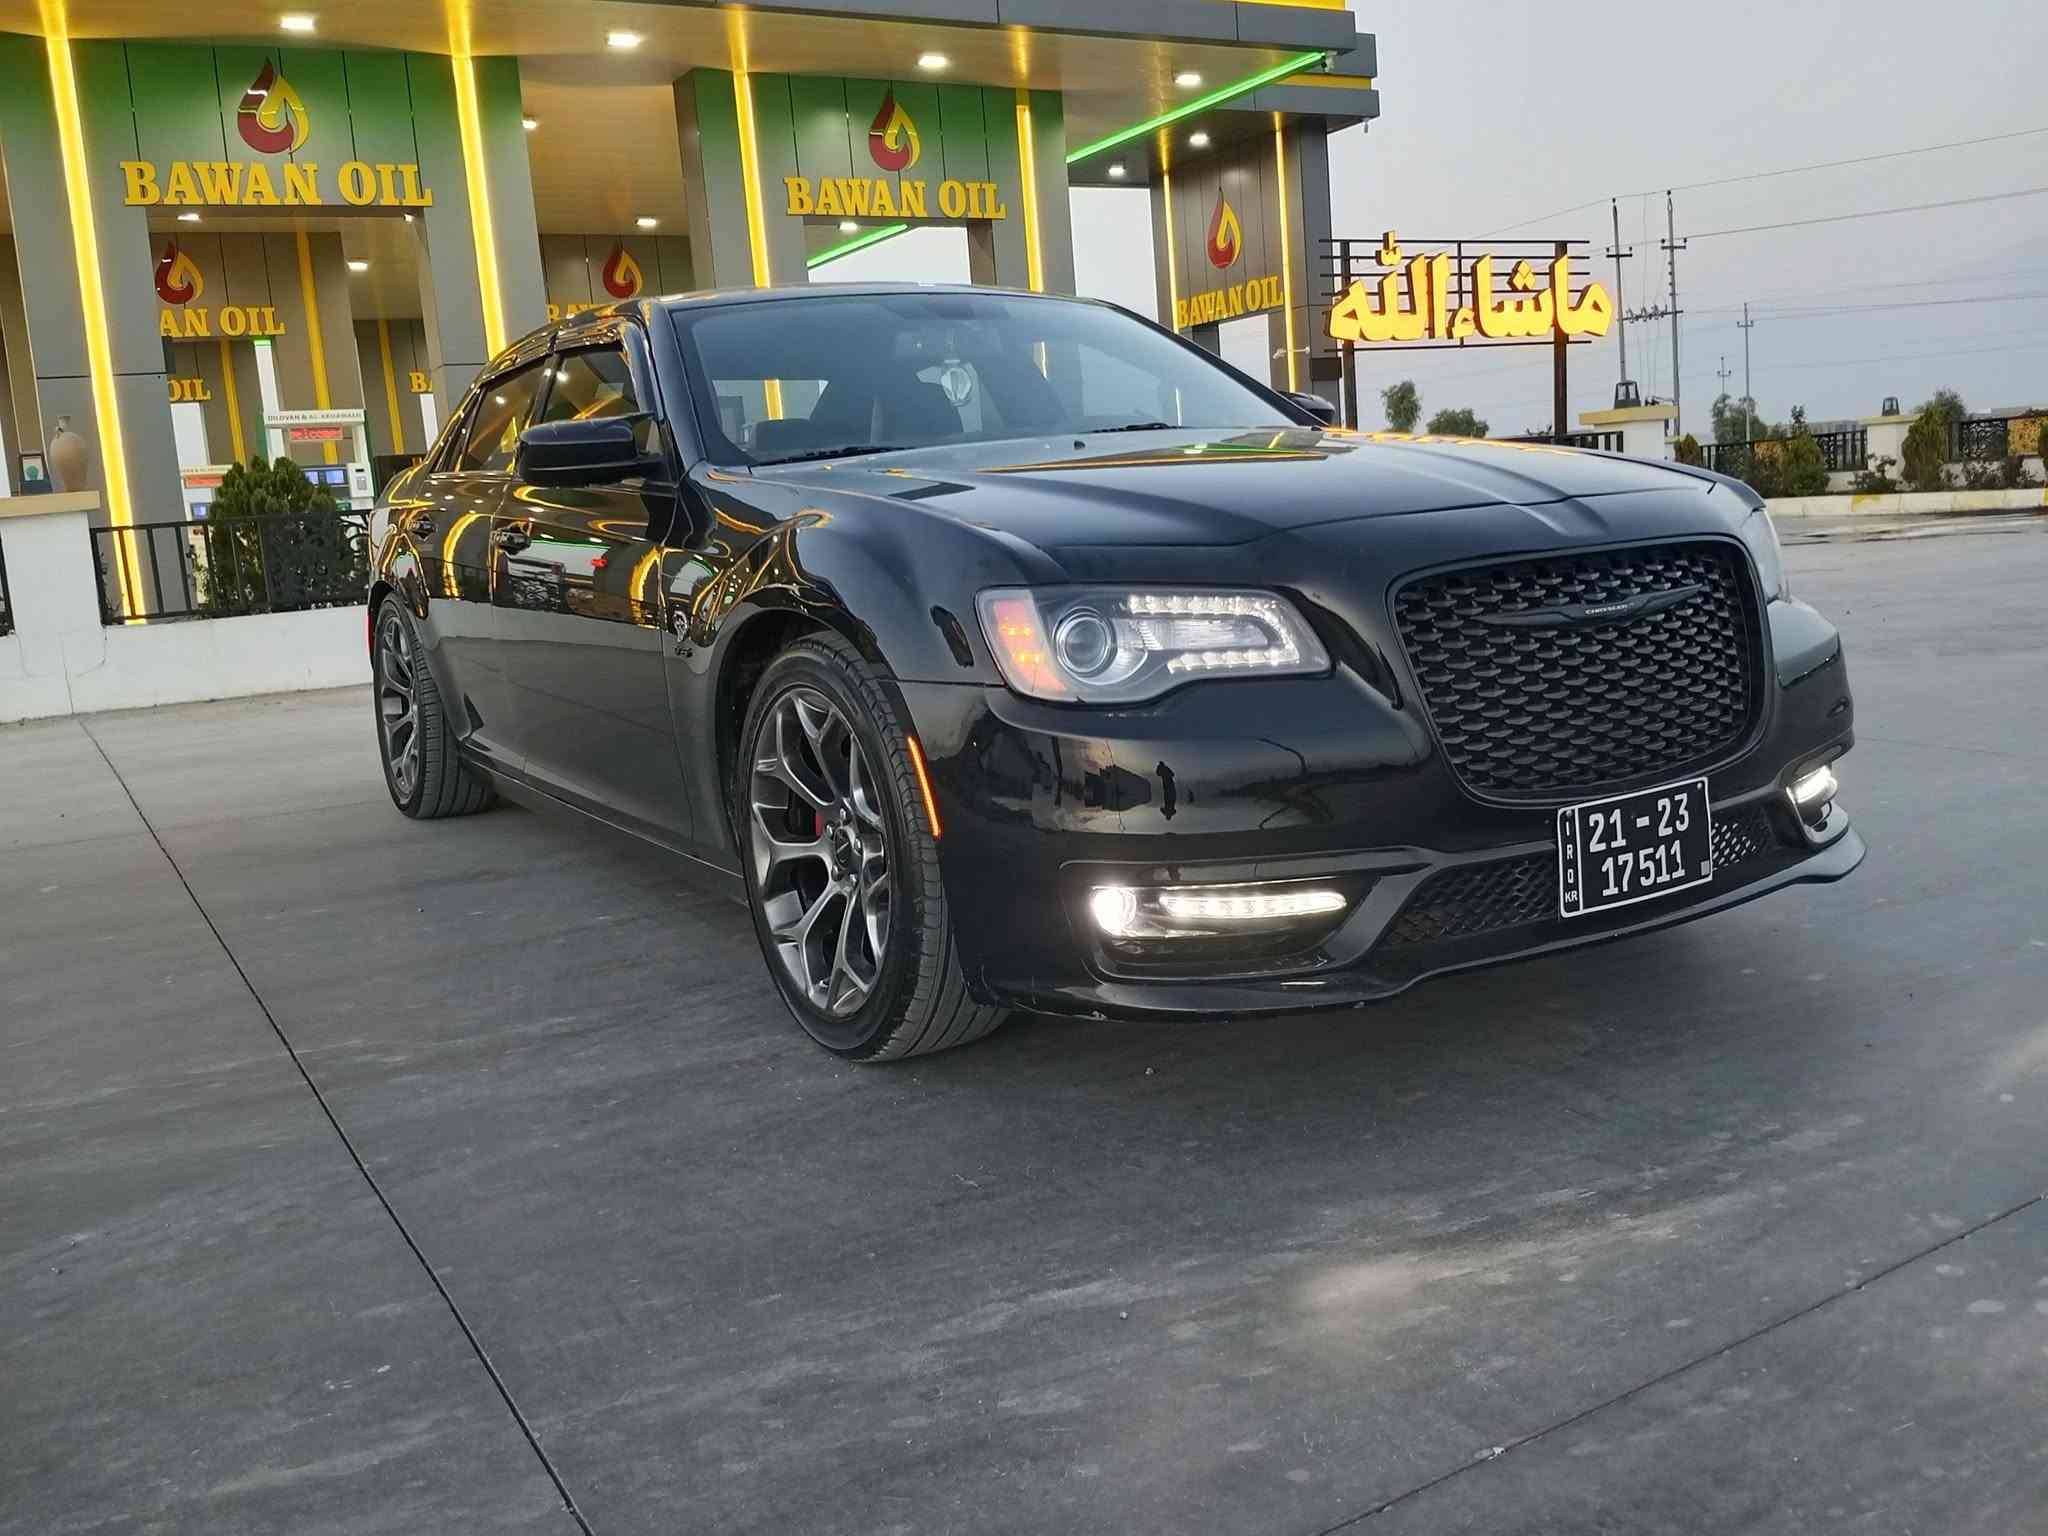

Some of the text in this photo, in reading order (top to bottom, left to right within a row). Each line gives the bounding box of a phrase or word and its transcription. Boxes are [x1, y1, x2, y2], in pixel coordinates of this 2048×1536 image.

[120, 160, 433, 207] BAWAN OIL
[784, 176, 1008, 220] BAWAN OIL
[219, 306, 286, 337] OIL
[1177, 275, 1284, 329] BAWAN OIL
[1601, 839, 1686, 897] 17511
[1564, 890, 1578, 903] KR
